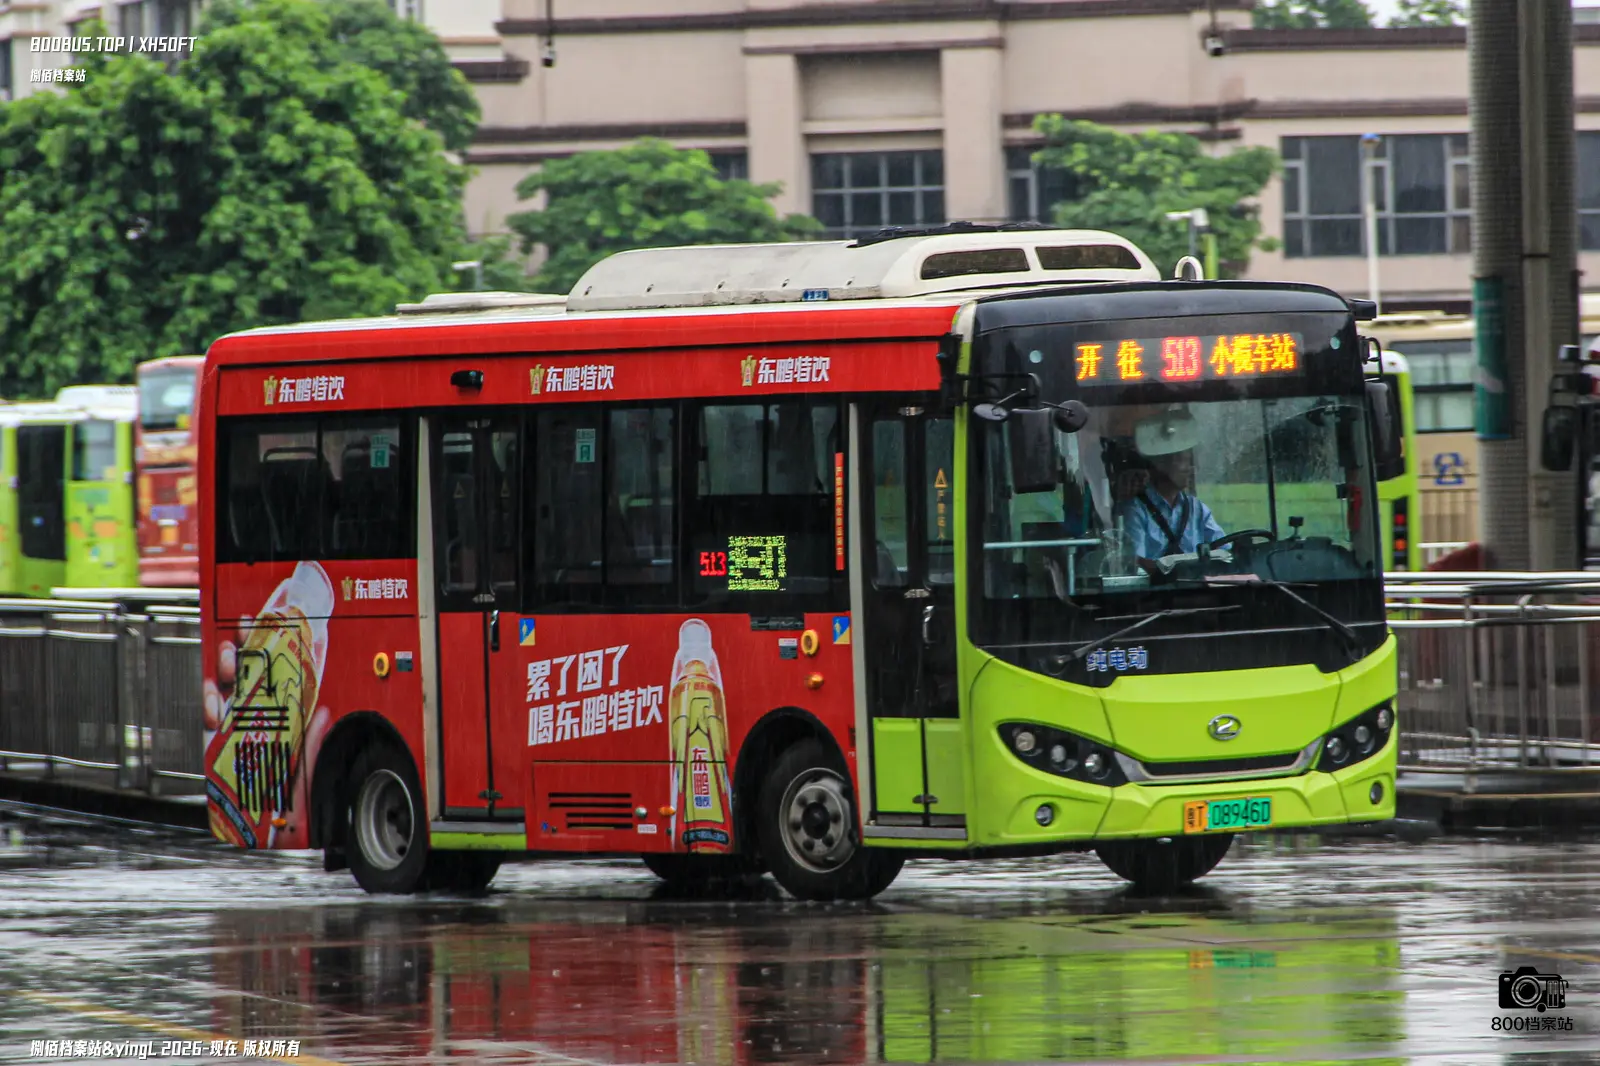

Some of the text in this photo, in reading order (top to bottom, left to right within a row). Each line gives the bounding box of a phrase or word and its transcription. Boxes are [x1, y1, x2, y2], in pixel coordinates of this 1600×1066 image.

[758, 356, 830, 384] 东鹏特饮
[1164, 337, 1200, 378] 513
[278, 375, 345, 403] 东鹏特饮
[546, 364, 615, 393] 东鹏特饮
[700, 551, 727, 577] 513
[354, 578, 408, 600] 东鹏特饮
[1086, 645, 1149, 672] 纯电动
[526, 644, 630, 702] 累了困了
[527, 685, 664, 747] 喝东鹏特饮
